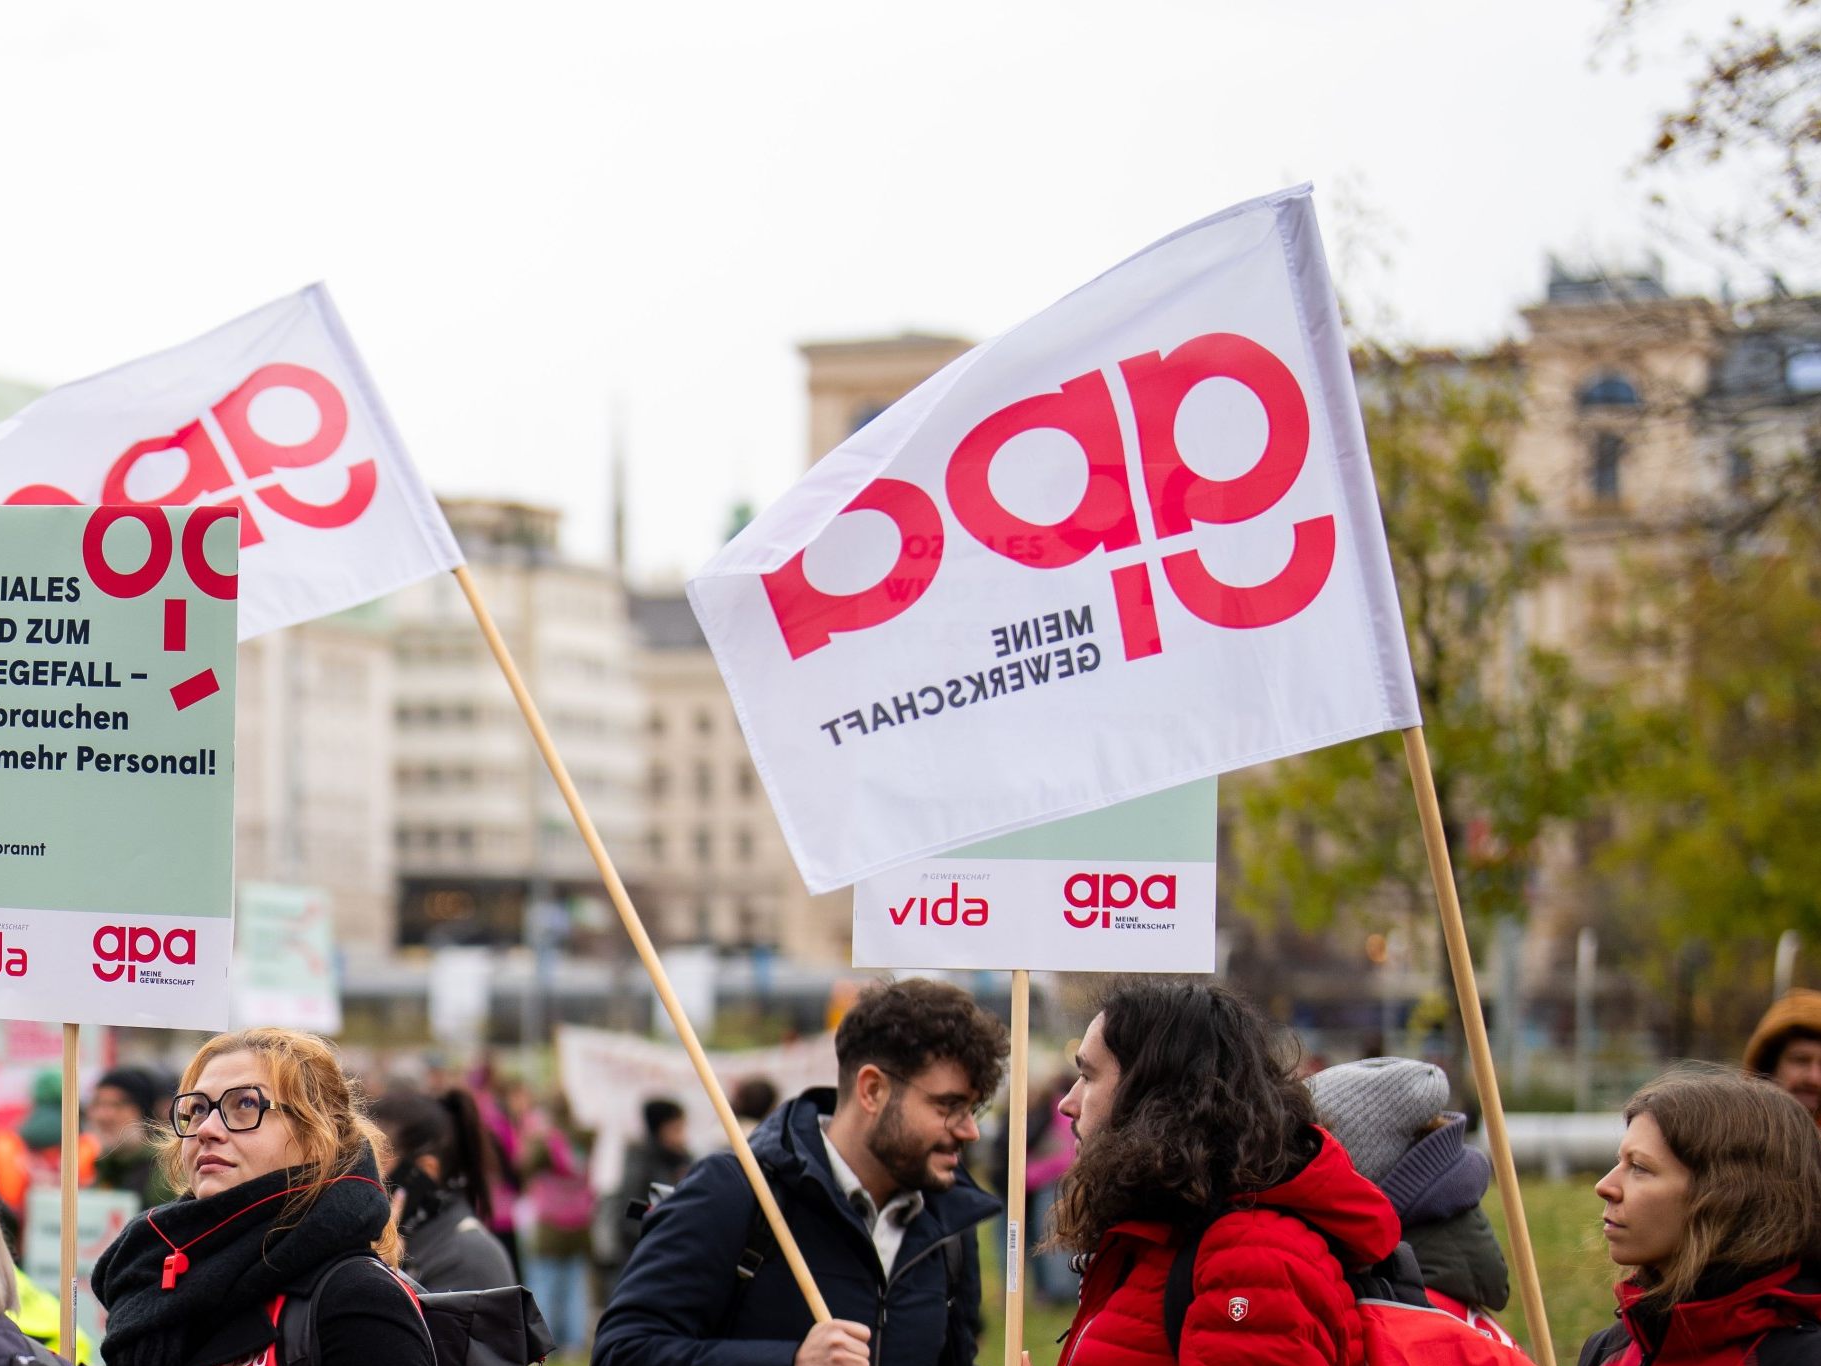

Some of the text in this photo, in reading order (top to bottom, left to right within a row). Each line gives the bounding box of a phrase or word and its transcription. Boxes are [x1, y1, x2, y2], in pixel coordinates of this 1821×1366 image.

[26, 618, 90, 645] ZUM
[76, 745, 216, 776] Personal!
[888, 872, 1176, 929] vida gpa
[92, 925, 196, 983] gpa
[139, 977, 195, 987] GEWERKSCHAFT
[140, 970, 162, 978] MEINE
